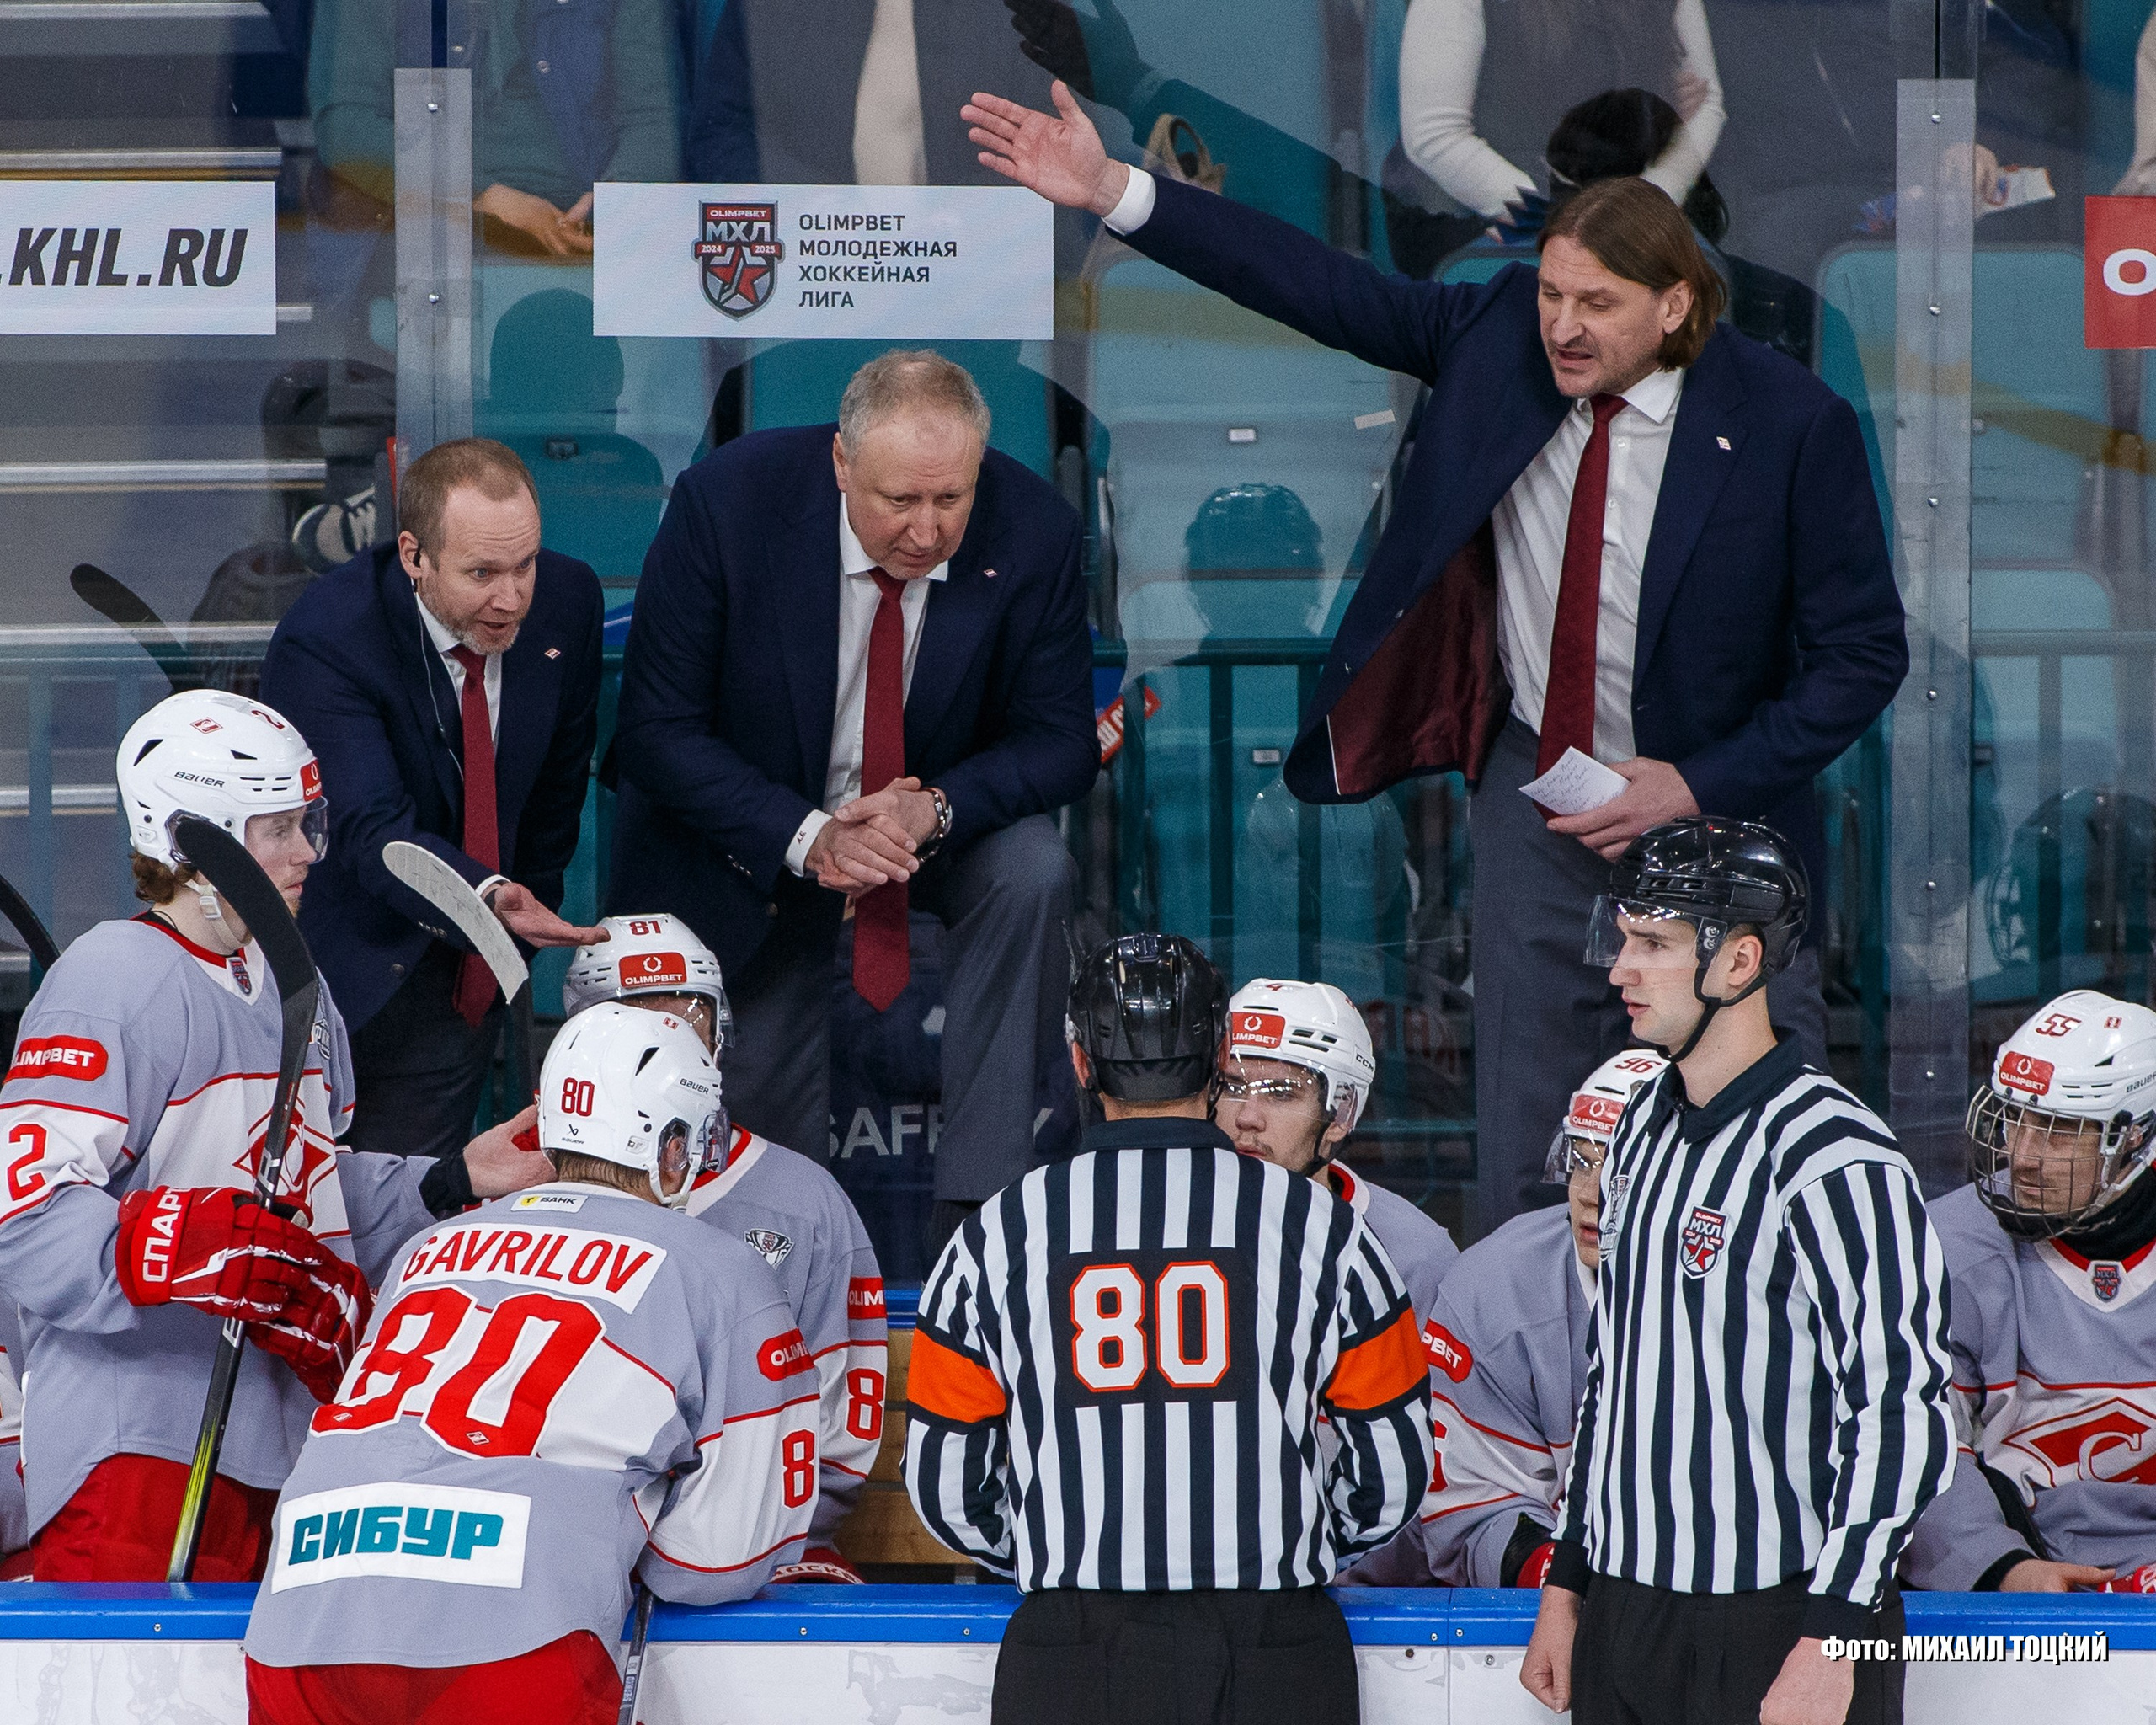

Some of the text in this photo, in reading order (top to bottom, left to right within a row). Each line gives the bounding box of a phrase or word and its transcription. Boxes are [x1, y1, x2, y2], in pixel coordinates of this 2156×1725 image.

[707, 222, 770, 242] МХЛ
[799, 215, 905, 230] OLIMPBET
[0, 228, 248, 286] KHL.RU
[701, 244, 723, 253] 2024
[799, 240, 957, 259] МОЛОДЕЖНАЯ
[799, 262, 930, 282] ХОККЕЙНАЯ
[799, 291, 854, 307] ЛИГА
[629, 921, 661, 936] 81
[625, 975, 683, 985] OLIMPBET
[2035, 1013, 2083, 1037] 55
[1231, 1033, 1278, 1044] LIMPBET
[14, 1048, 95, 1067] LIMPBET
[1614, 1057, 1662, 1073] 96
[2000, 1072, 2046, 1092] OLIMPBET
[561, 1077, 595, 1117] 80
[7, 1123, 47, 1201] 2
[1689, 1218, 1721, 1238] МХЛ
[403, 1231, 653, 1294] GAVRILOV
[1070, 1261, 1230, 1392] 80
[310, 1286, 606, 1458] 80
[846, 1368, 884, 1441] 8
[782, 1429, 815, 1509] 8
[288, 1506, 504, 1566] СИБУР
